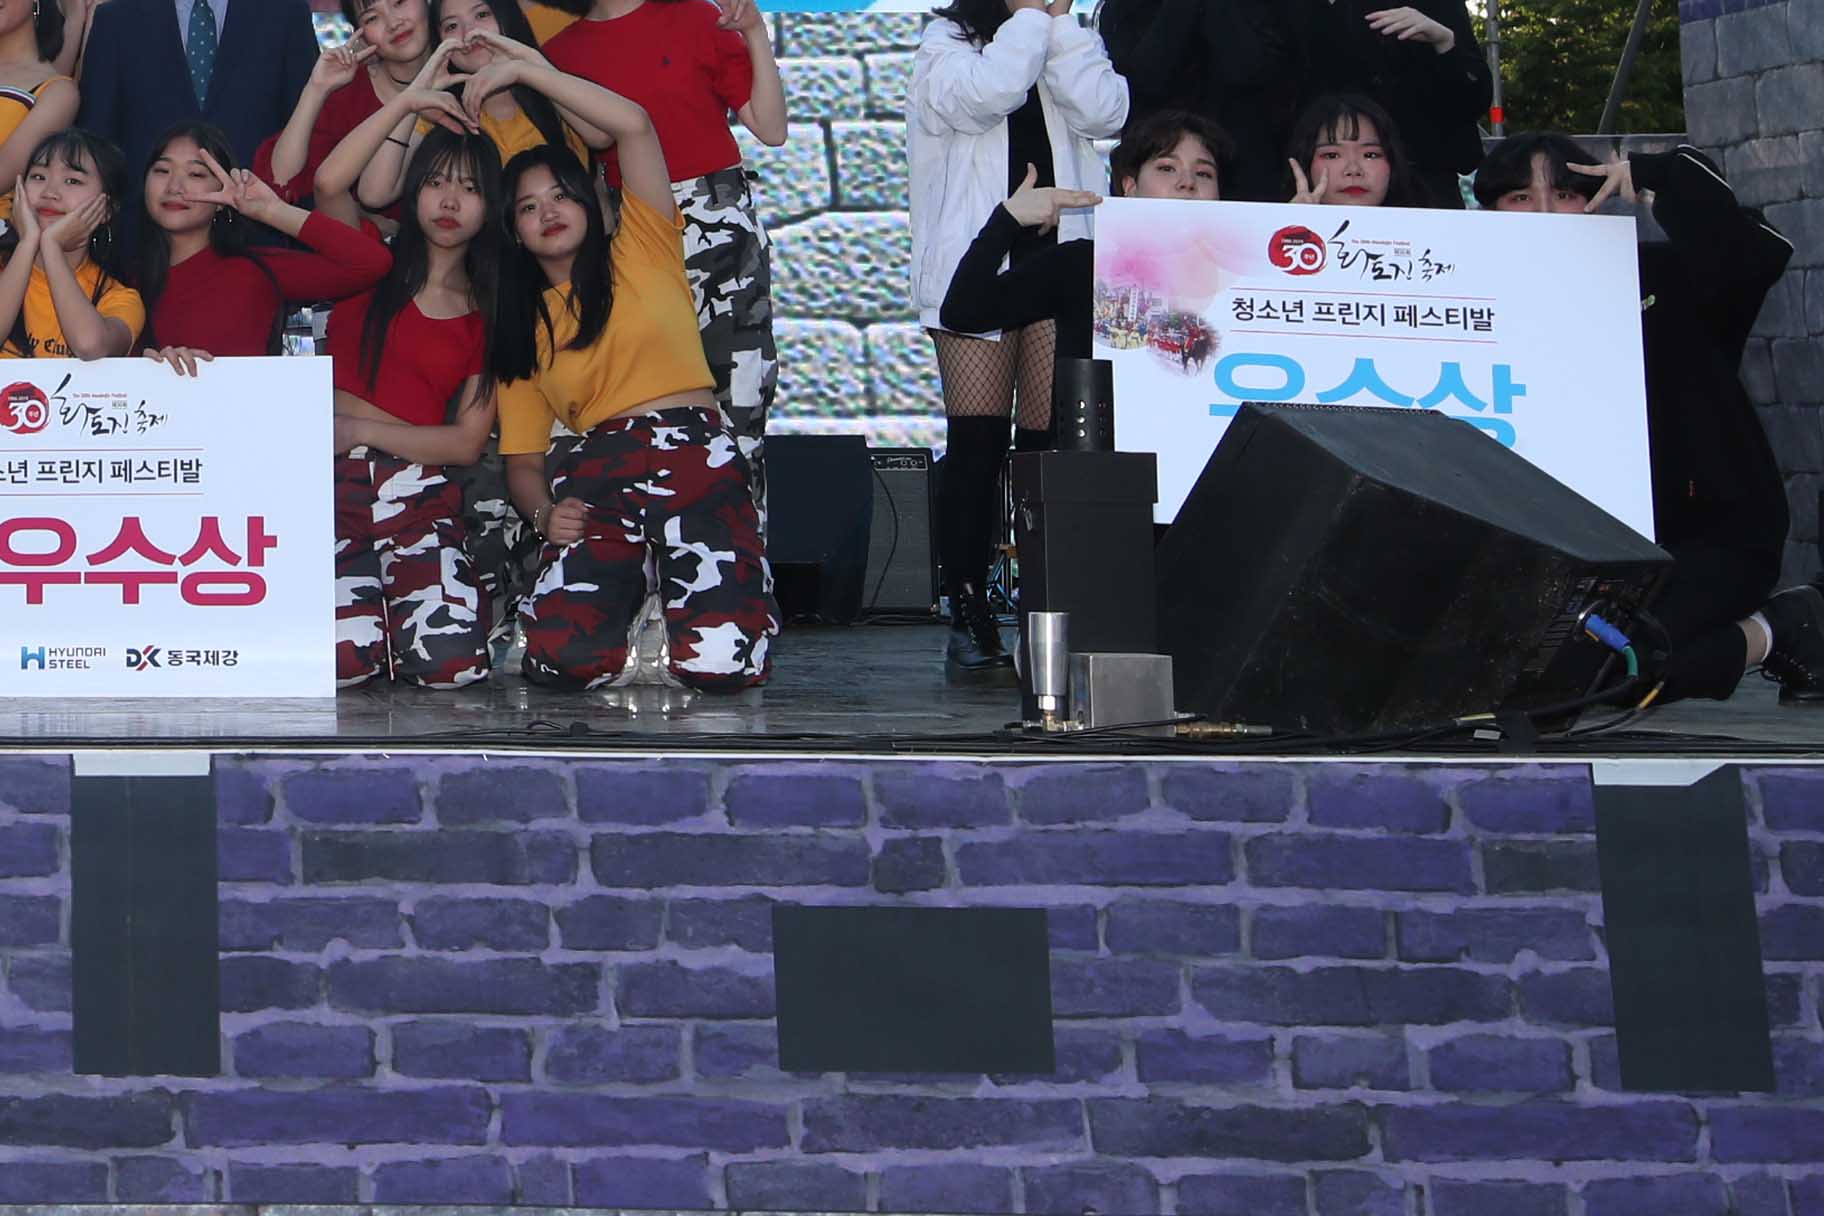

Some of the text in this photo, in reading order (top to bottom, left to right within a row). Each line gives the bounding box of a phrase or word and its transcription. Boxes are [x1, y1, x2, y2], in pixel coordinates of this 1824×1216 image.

[1231, 297, 1495, 332] 청소년 프린지 페스티발
[36, 460, 104, 484] 프린지
[110, 458, 203, 484] 페스티발
[48, 647, 106, 657] HYUNDAI
[167, 649, 239, 666] 동국제강
[48, 659, 91, 669] STEEL
